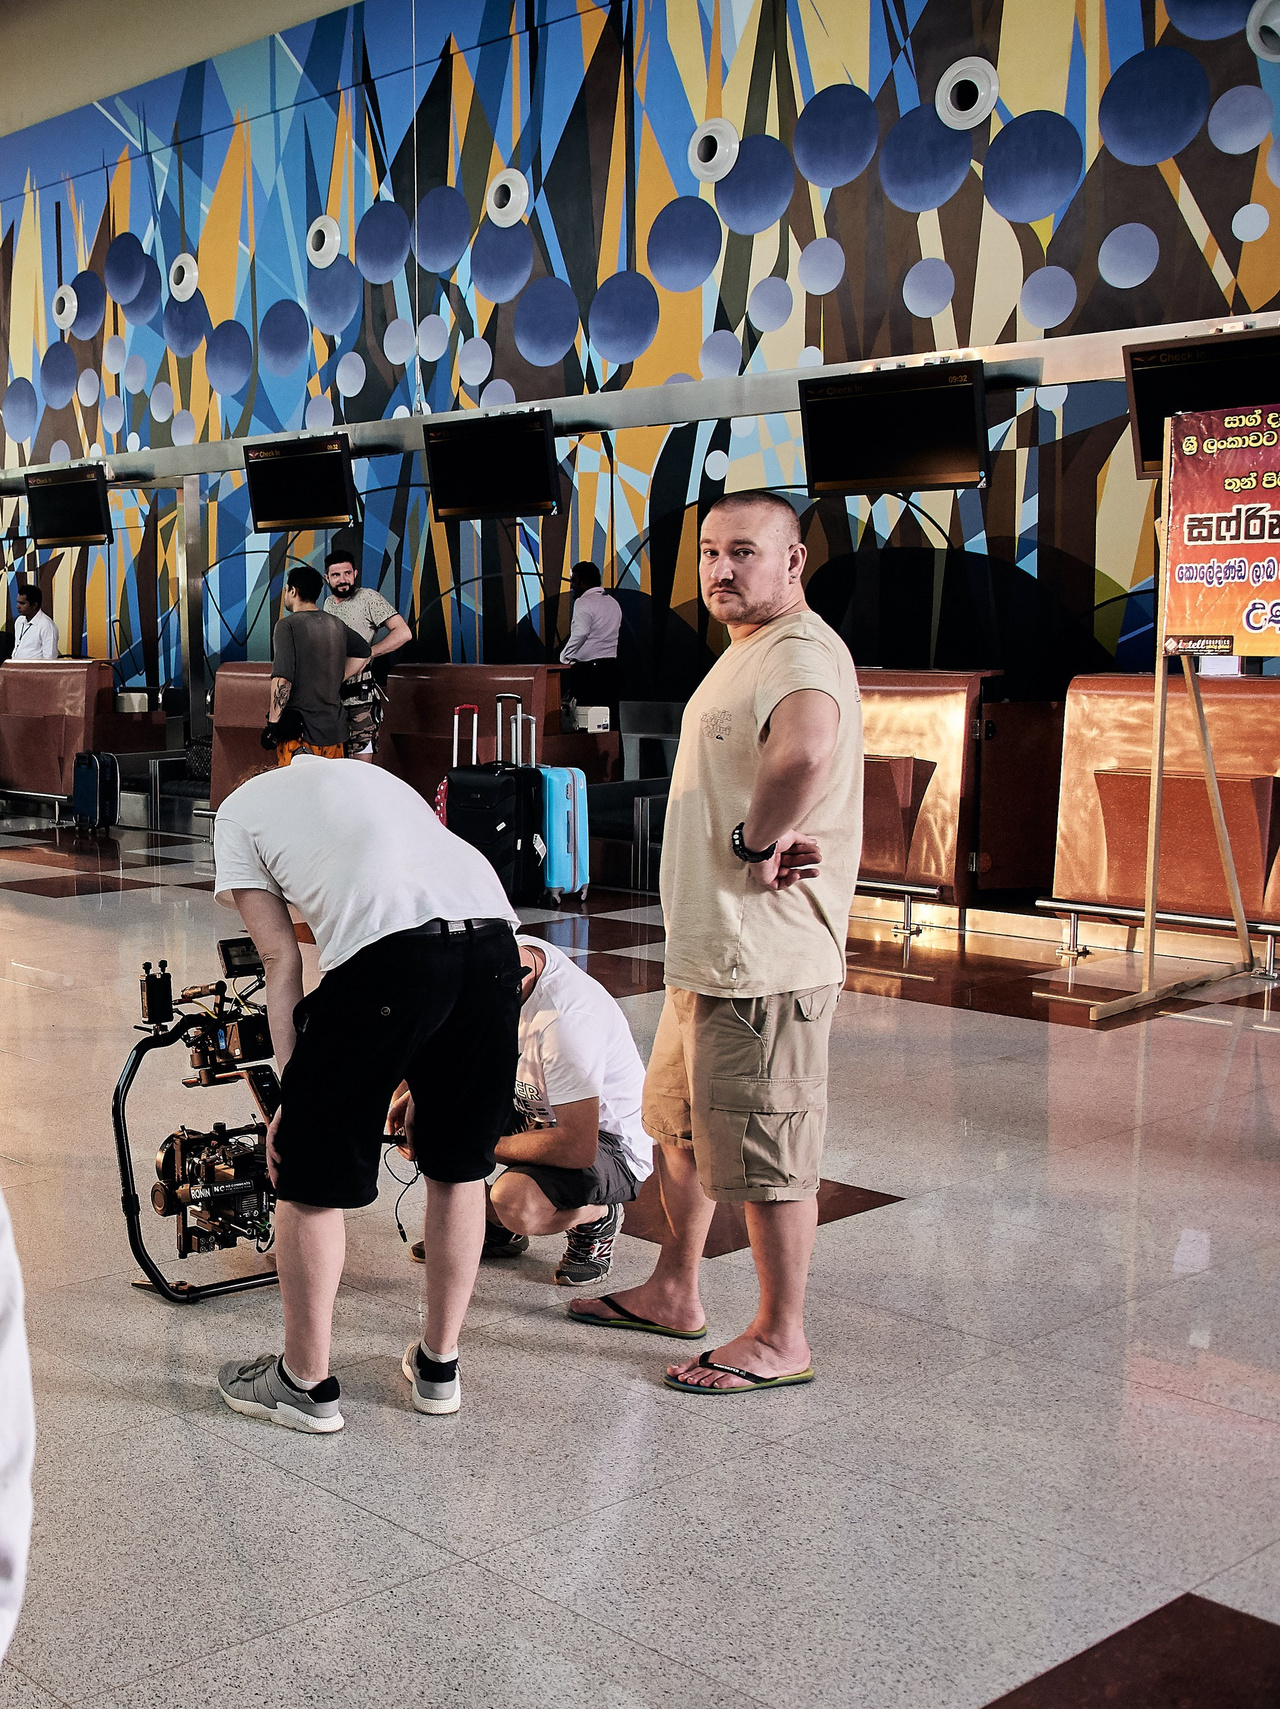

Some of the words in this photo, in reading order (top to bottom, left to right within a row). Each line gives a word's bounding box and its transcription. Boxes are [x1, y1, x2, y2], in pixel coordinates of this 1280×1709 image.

[948, 375, 968, 384] 09:32
[1202, 430, 1278, 454] ලංකාවට
[514, 1080, 543, 1102] ER
[190, 1187, 211, 1200] RONIN
